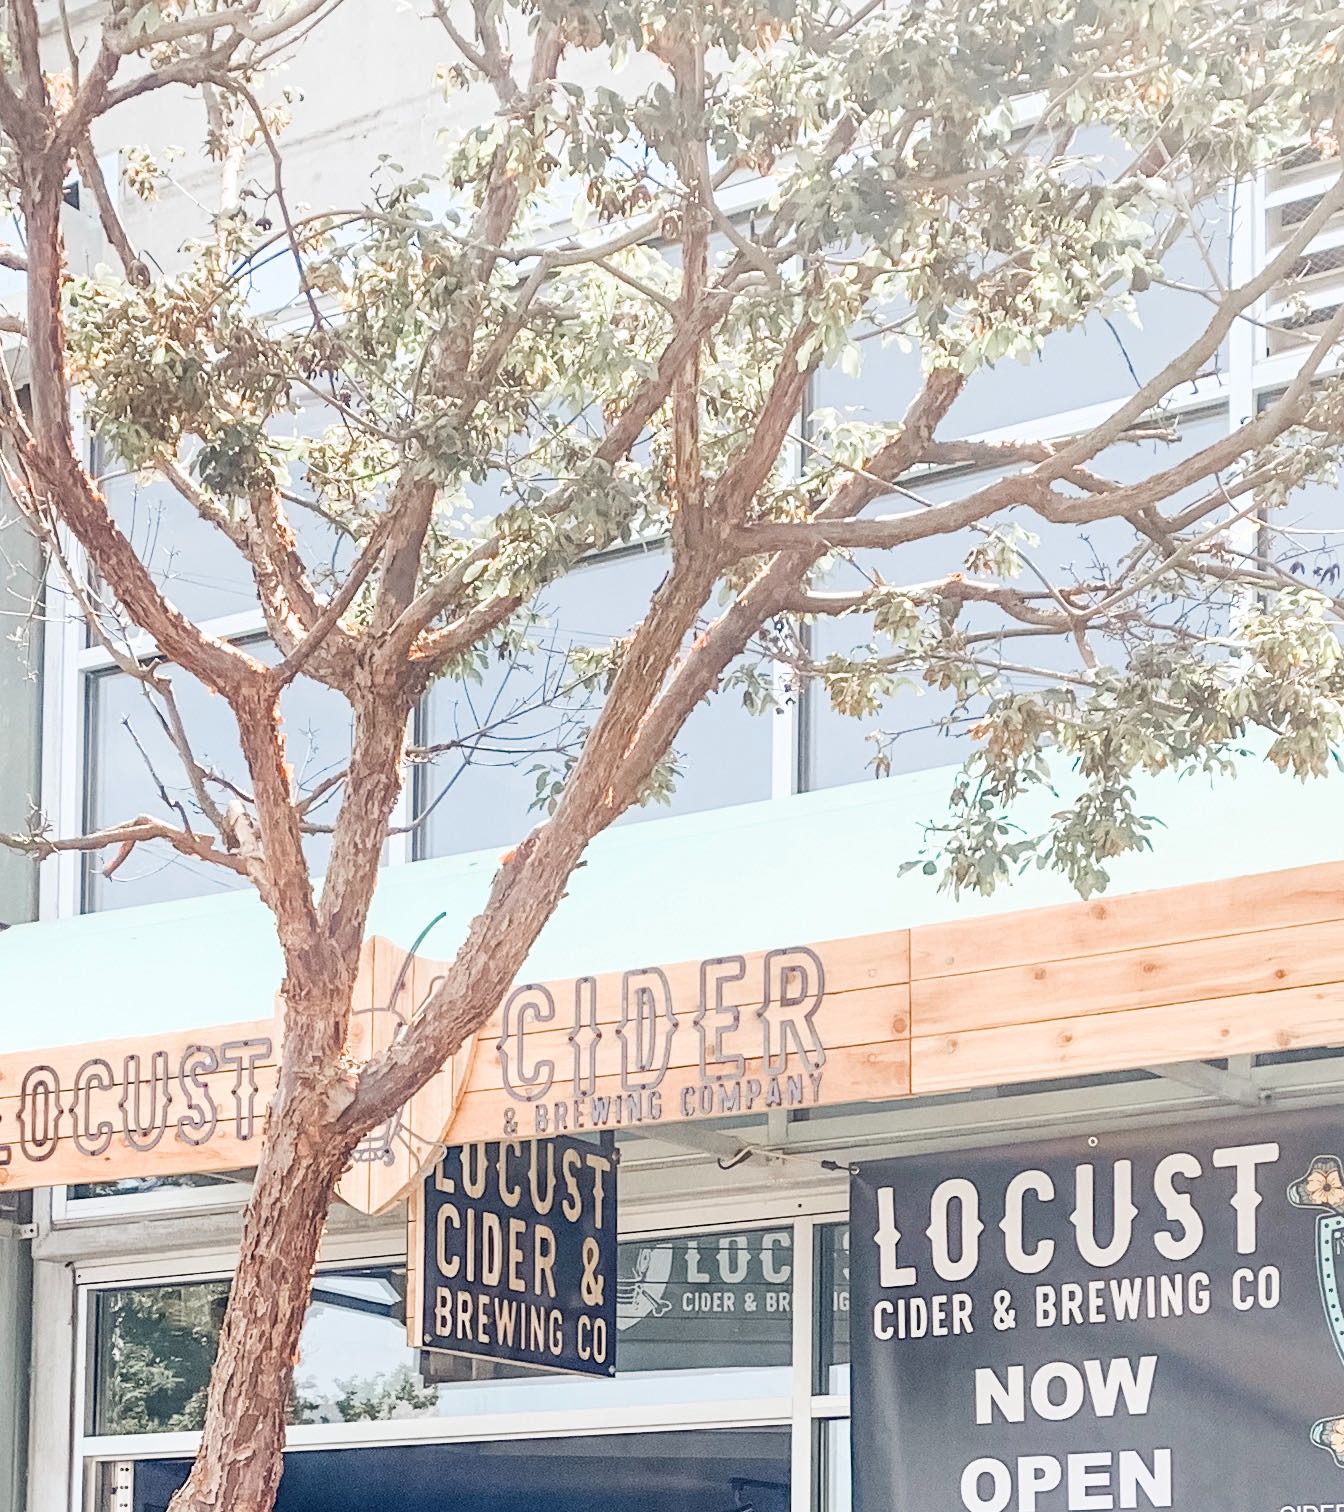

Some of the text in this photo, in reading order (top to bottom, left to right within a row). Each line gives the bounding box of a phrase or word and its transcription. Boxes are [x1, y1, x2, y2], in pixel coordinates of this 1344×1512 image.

[497, 946, 826, 1102] CIDER
[502, 1071, 823, 1136] & BREWING COMPANY
[436, 1202, 605, 1306] CIDER &
[873, 1142, 1280, 1289] LOCUST
[435, 1286, 606, 1364] BREWING CO
[682, 1292, 735, 1312] CIDER
[744, 1292, 757, 1312] &
[872, 1265, 1281, 1341] CIDER & BREWING CO
[974, 1355, 1158, 1425] NOW
